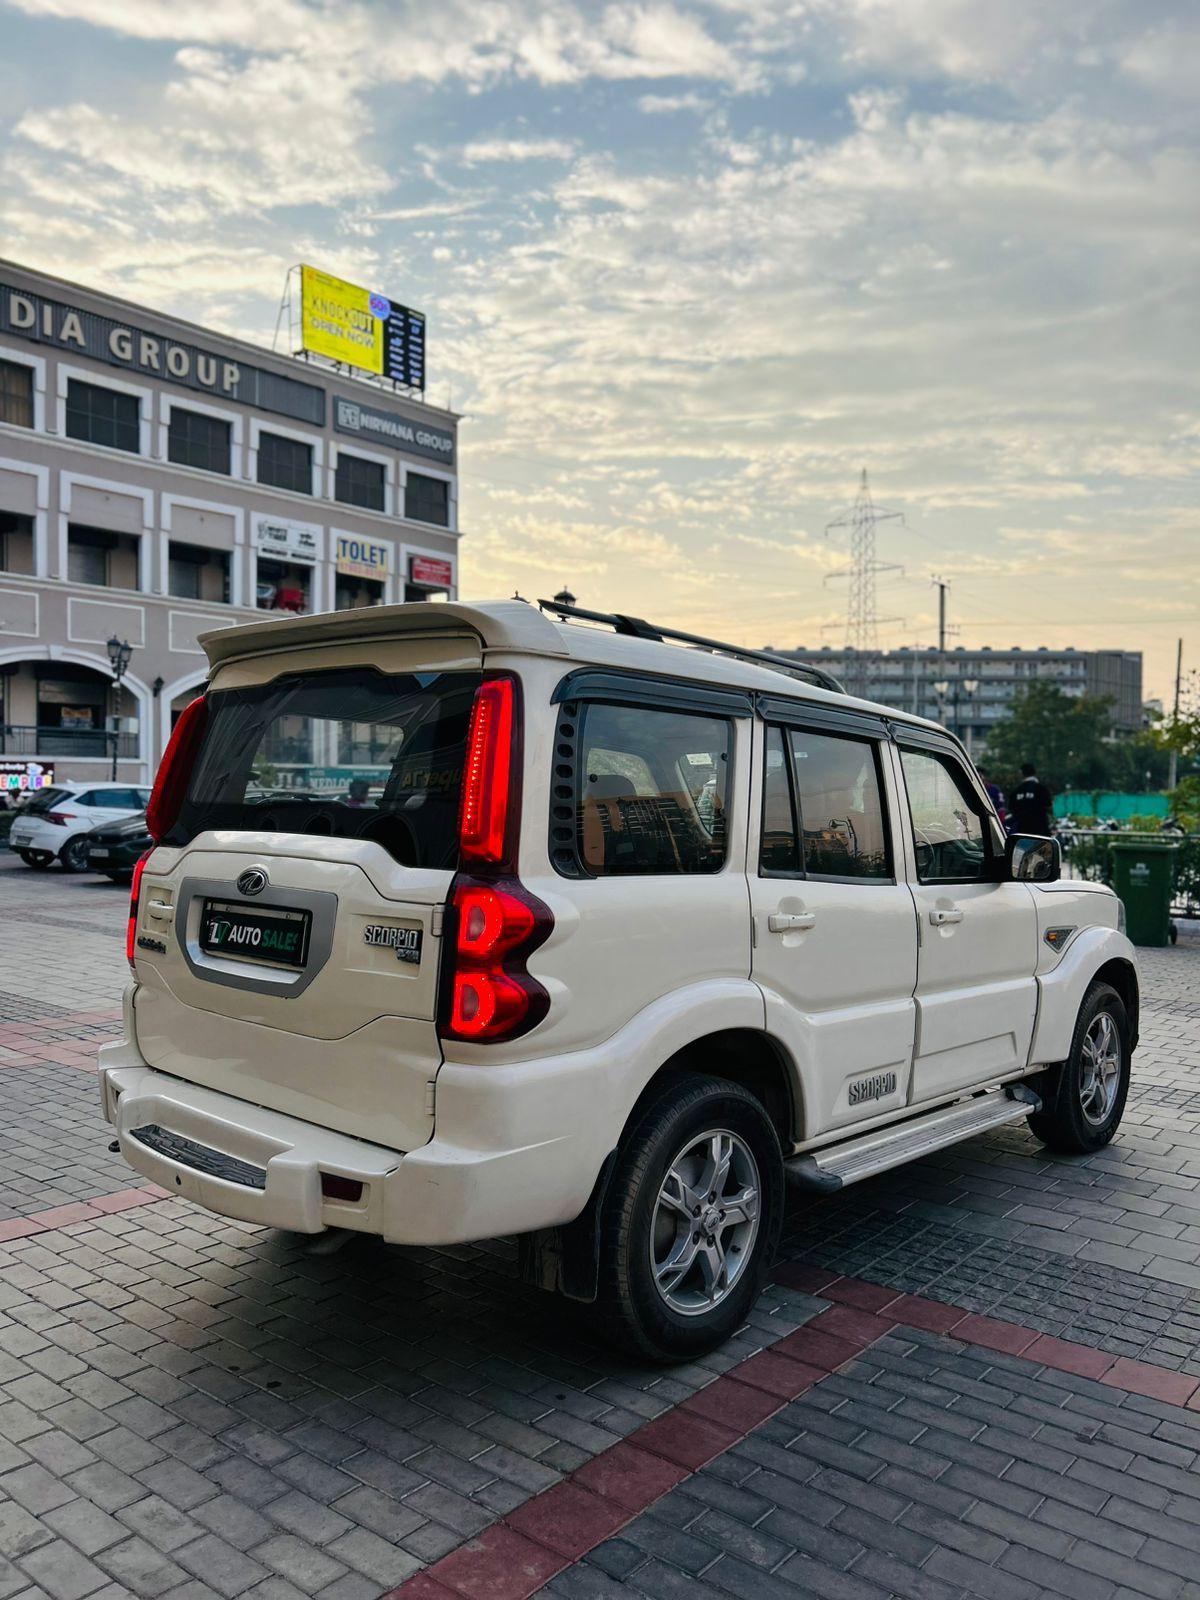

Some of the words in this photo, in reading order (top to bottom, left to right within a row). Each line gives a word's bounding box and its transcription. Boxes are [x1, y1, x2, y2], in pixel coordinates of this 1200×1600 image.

[9, 294, 86, 347] DIA
[109, 328, 240, 391] GROUP
[347, 331, 374, 349] NOW
[360, 413, 414, 442] NIRWANA
[416, 431, 453, 452] GROUP
[227, 924, 262, 946] AUTO
[364, 925, 419, 949] SCORPIO
[848, 1071, 897, 1106] SCORPIO
